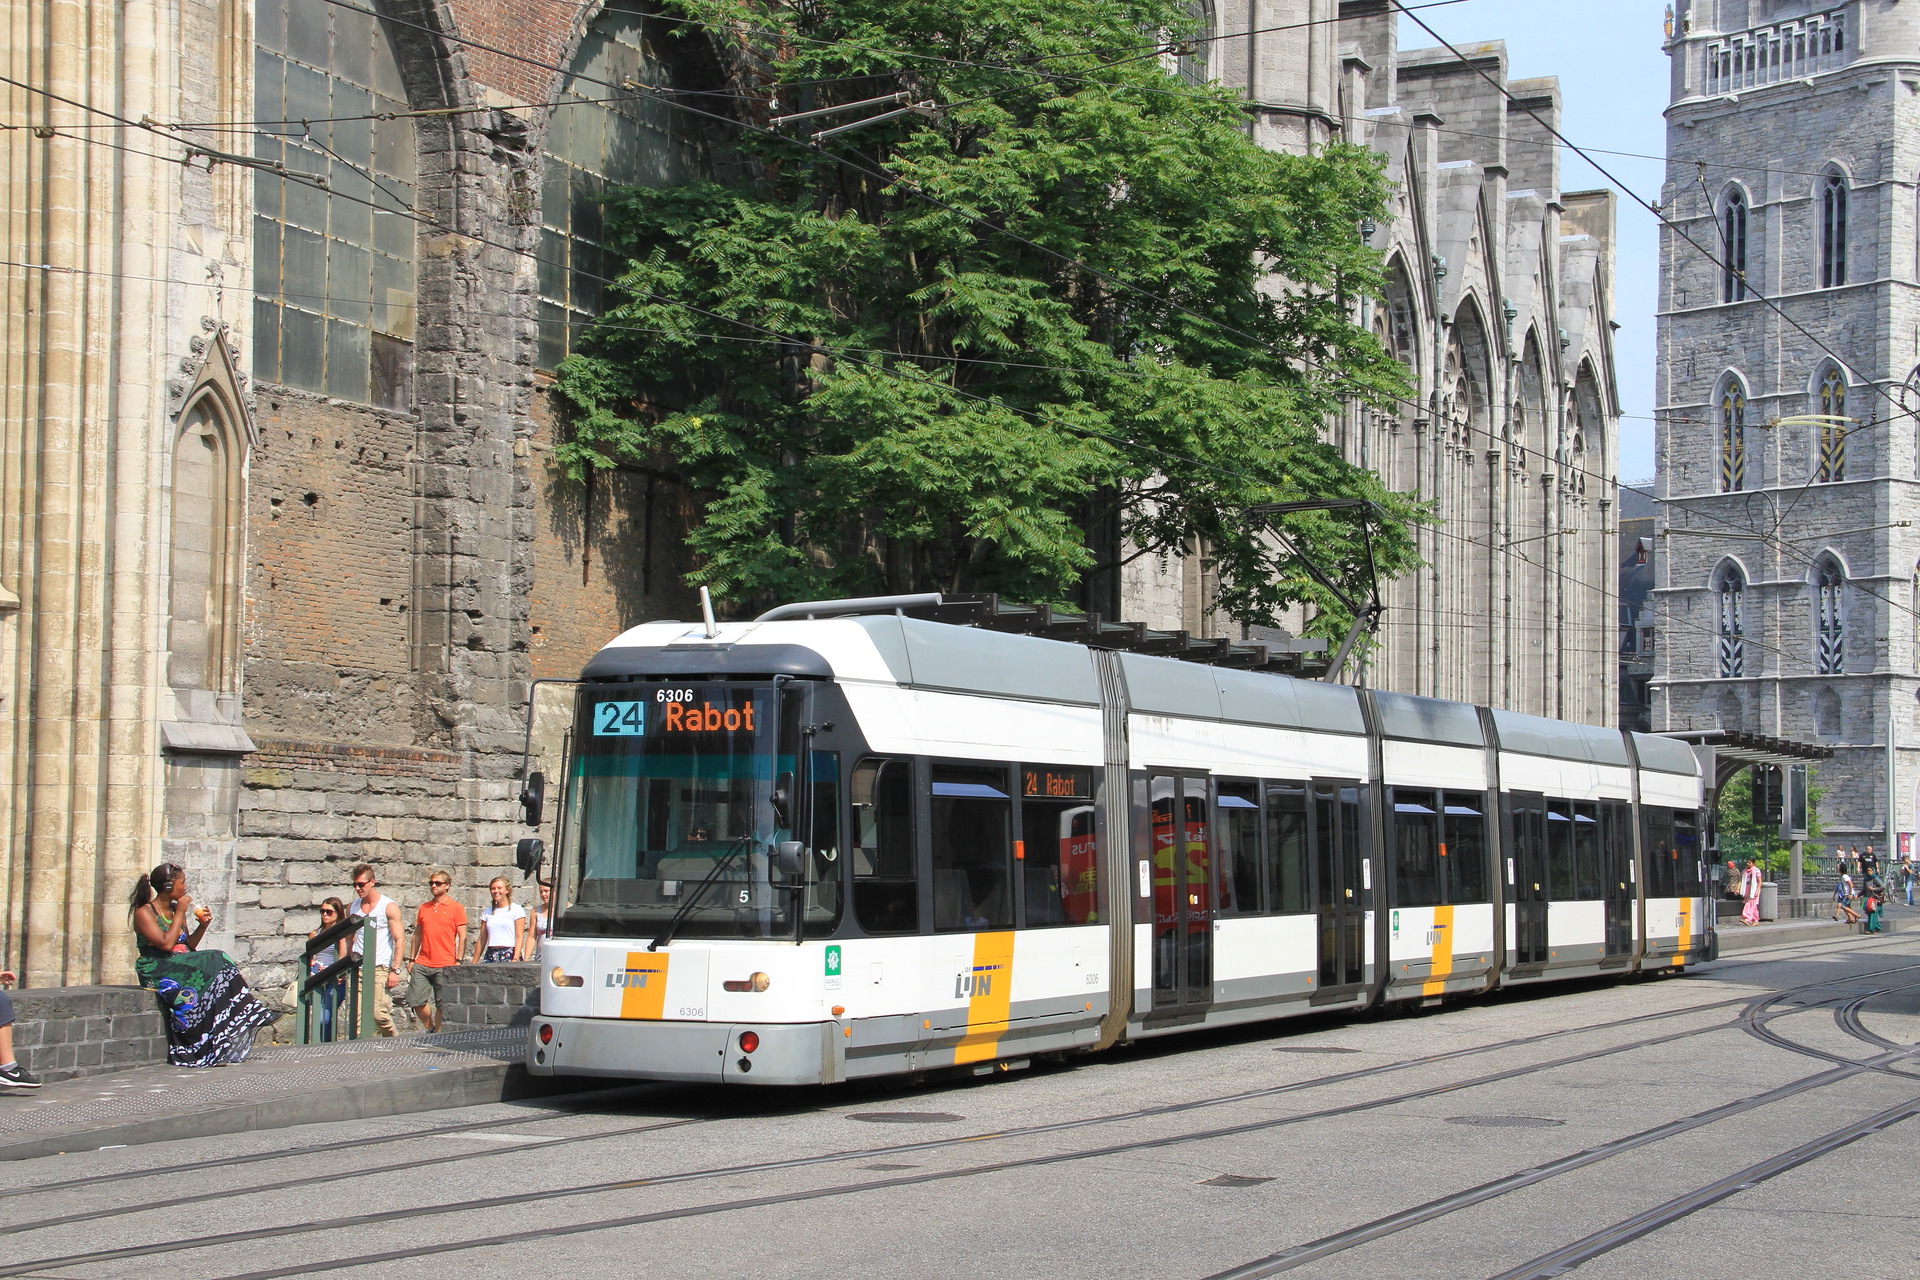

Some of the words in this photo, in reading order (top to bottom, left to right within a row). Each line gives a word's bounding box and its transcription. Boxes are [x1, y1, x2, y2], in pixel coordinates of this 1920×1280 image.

[657, 689, 694, 702] 6306
[602, 702, 643, 733] 24
[666, 701, 755, 732] Rabot
[1026, 771, 1038, 795] 24
[1046, 772, 1075, 796] Rabot
[739, 889, 749, 904] 5
[1085, 973, 1099, 985] 6306
[679, 1007, 704, 1018] 6306
